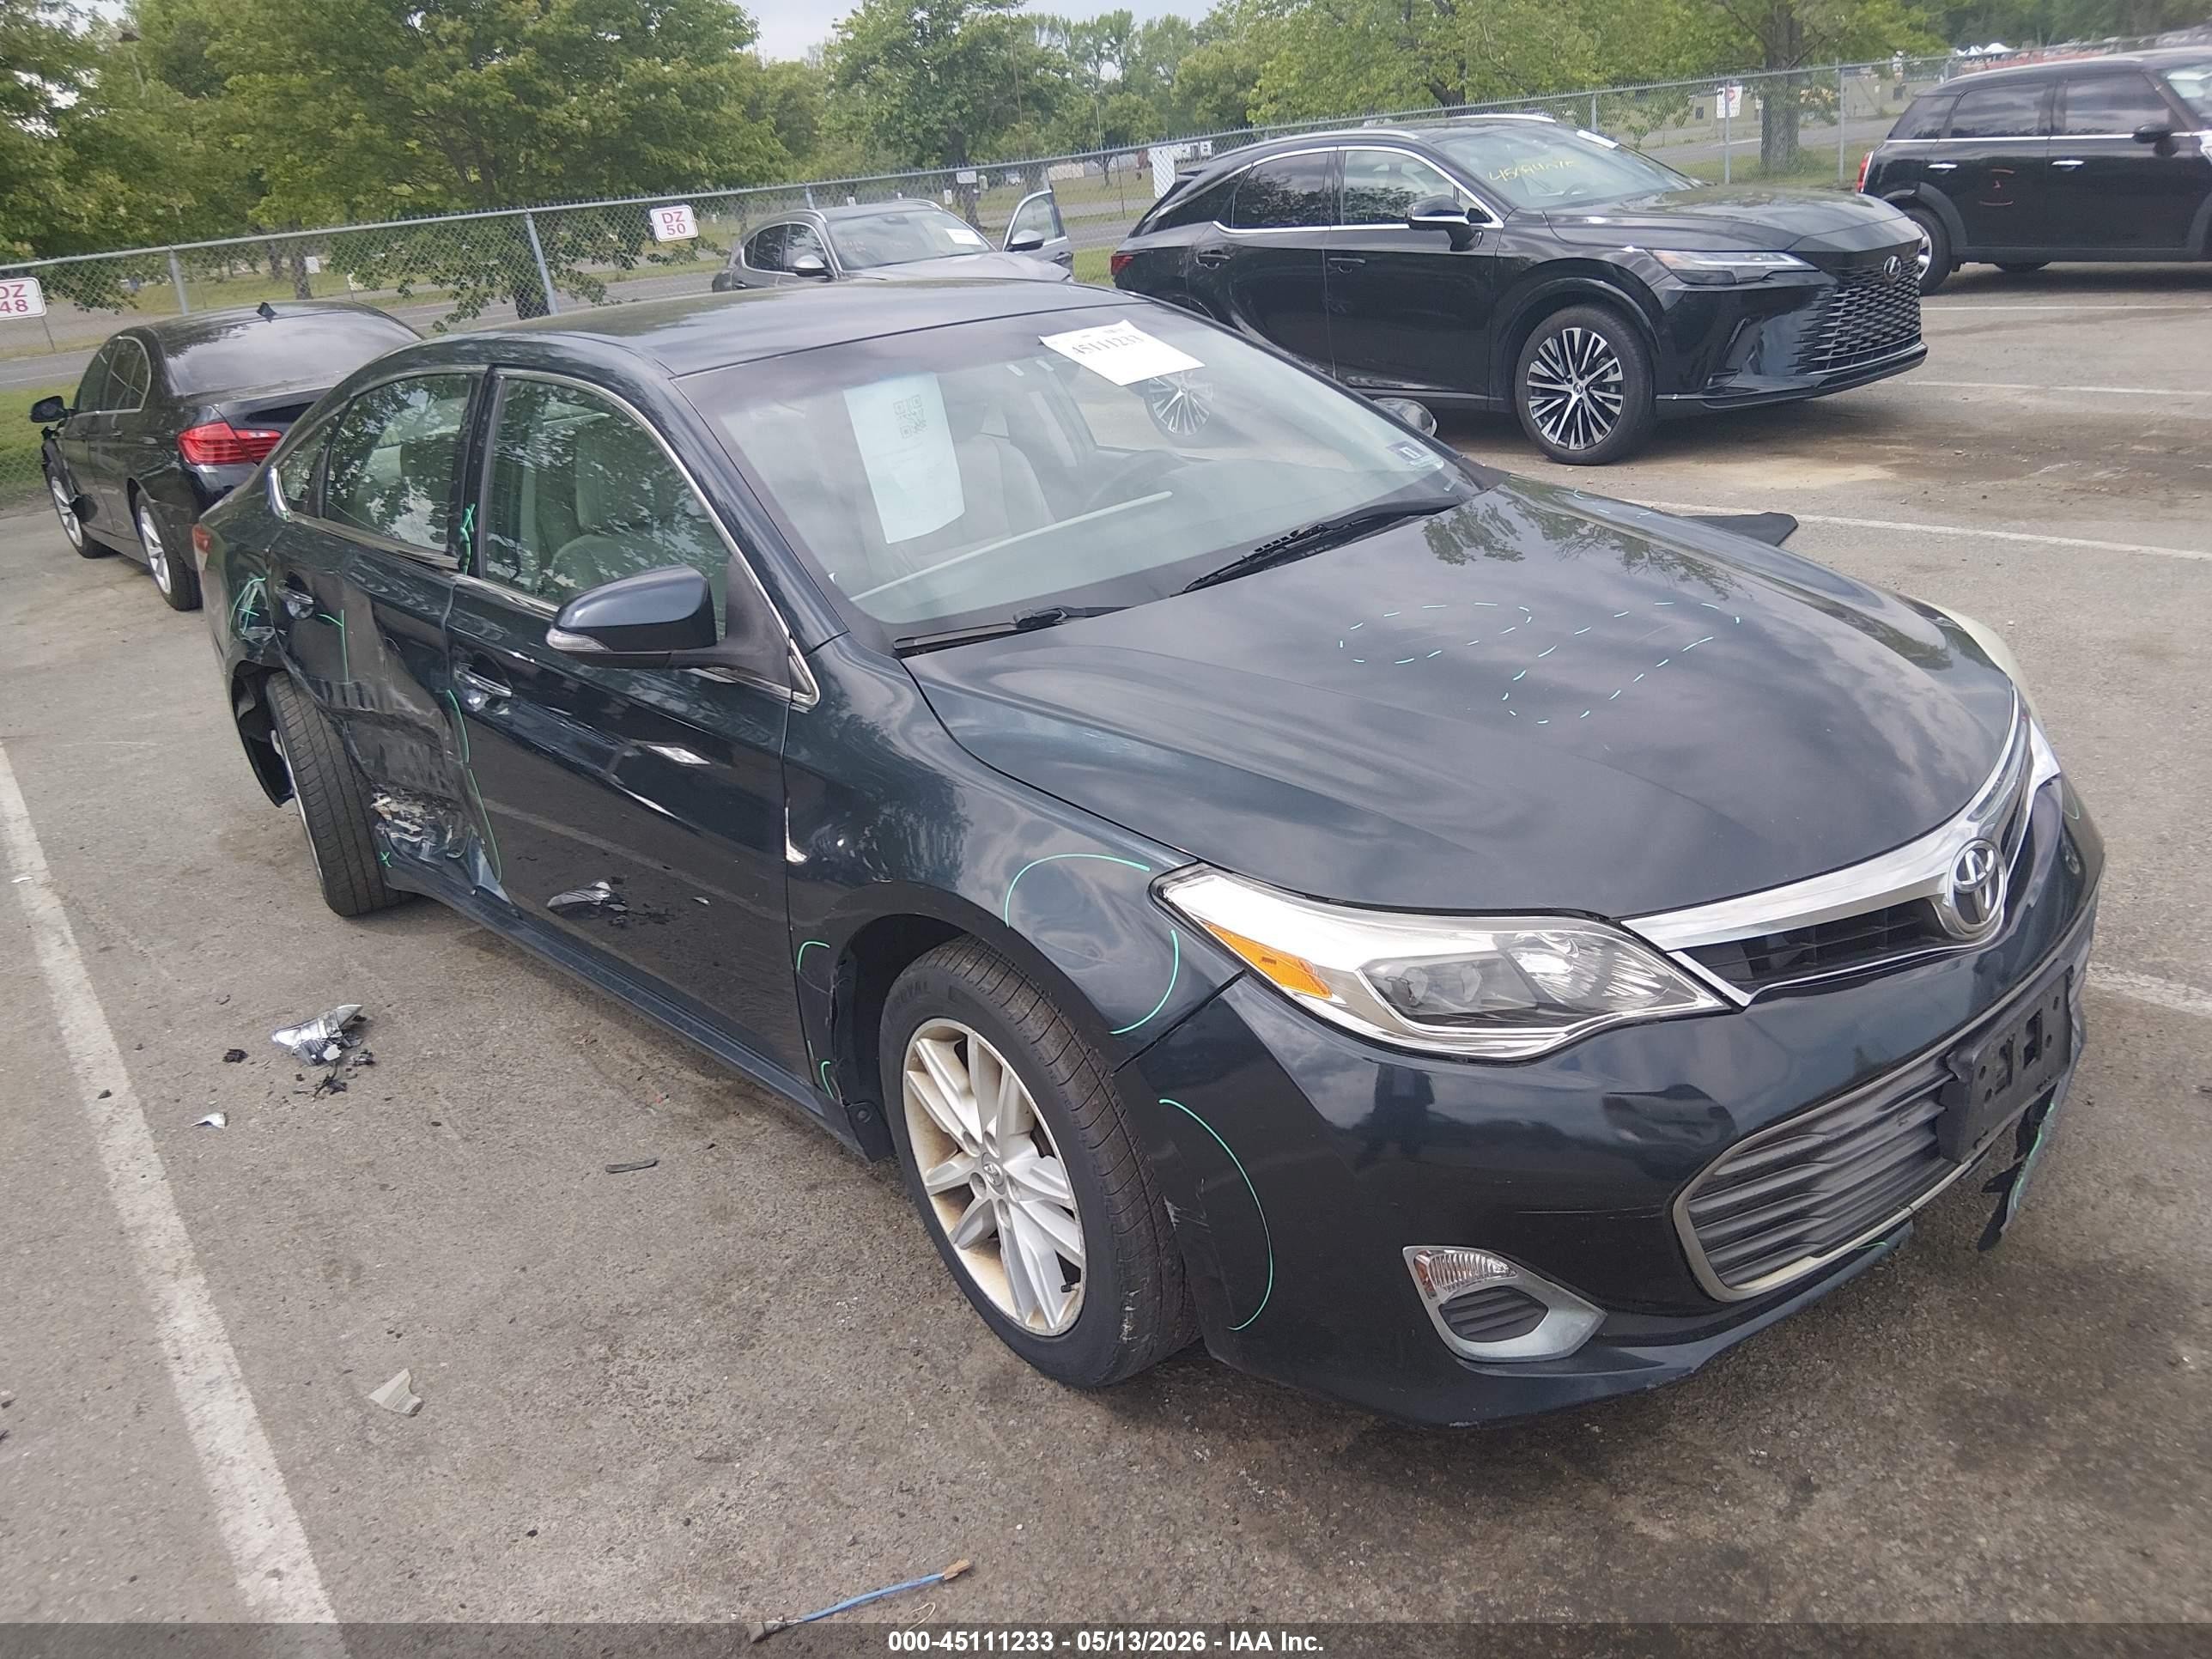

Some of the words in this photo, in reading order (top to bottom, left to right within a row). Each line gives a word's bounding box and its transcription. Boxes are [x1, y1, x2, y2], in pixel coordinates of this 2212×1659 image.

[661, 210, 685, 224] DZ
[666, 222, 686, 235] 50
[0, 299, 28, 313] 48
